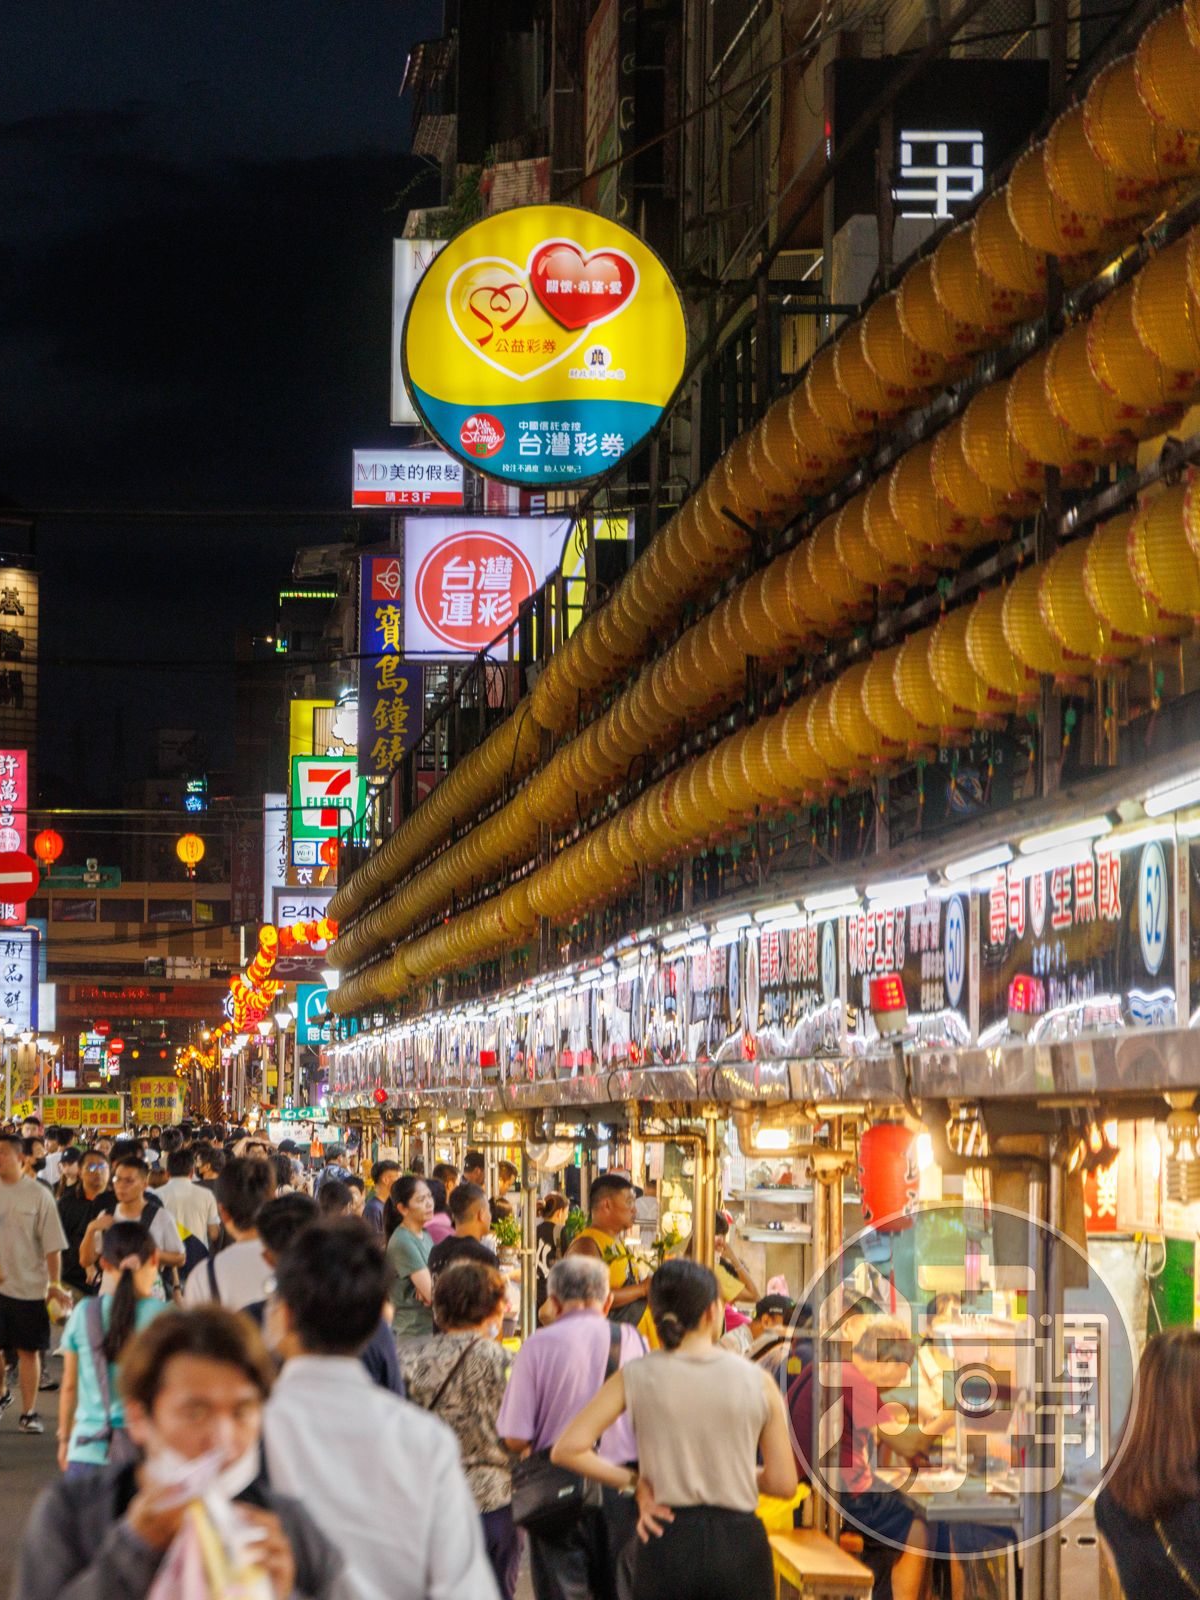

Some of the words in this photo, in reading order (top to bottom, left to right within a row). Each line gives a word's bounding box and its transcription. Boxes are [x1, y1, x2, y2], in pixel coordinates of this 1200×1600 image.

[495, 338, 557, 354] 公益彩券
[518, 431, 625, 457] 台灣彩券
[390, 463, 460, 482] 美的假髮
[441, 555, 513, 592] 台灣
[438, 592, 513, 627] 運彩
[1145, 866, 1161, 944] 52
[948, 917, 962, 984] 50
